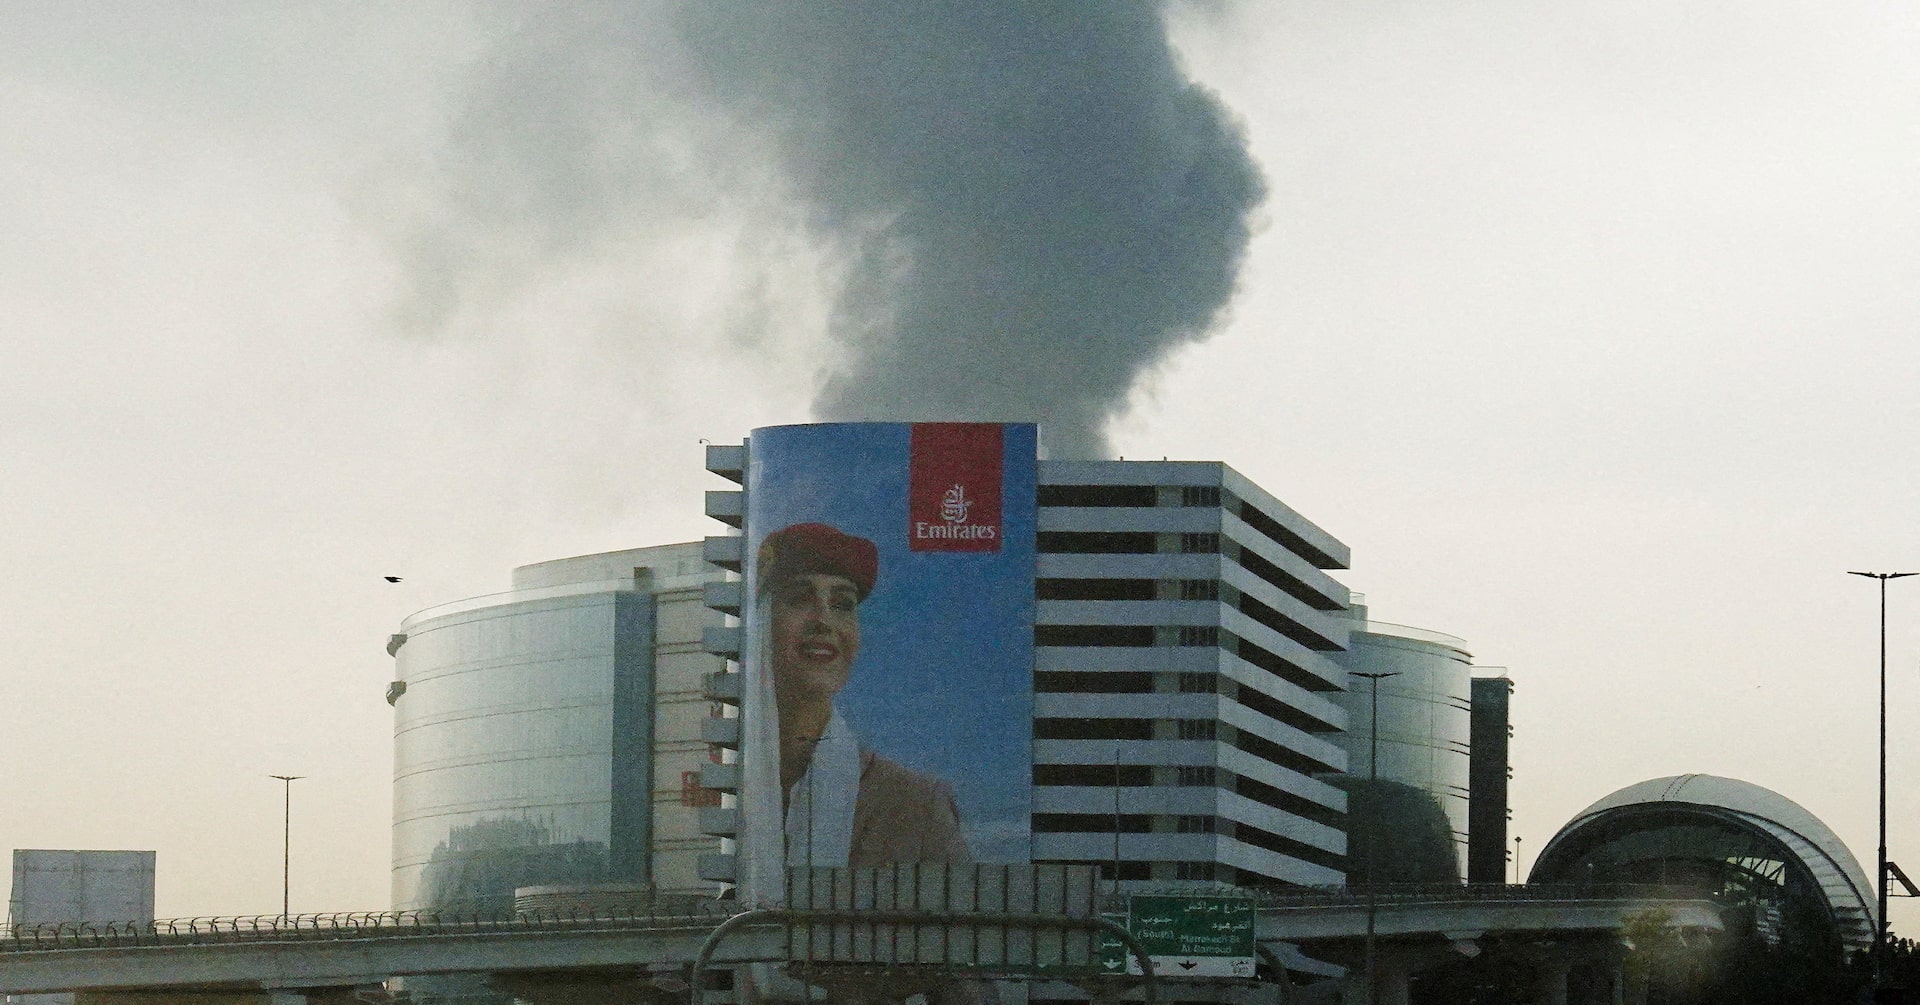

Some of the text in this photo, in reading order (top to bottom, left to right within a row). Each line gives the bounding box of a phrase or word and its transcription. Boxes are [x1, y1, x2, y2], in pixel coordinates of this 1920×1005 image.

[916, 521, 996, 539] Emirates
[1184, 900, 1250, 914] شارع مراكش
